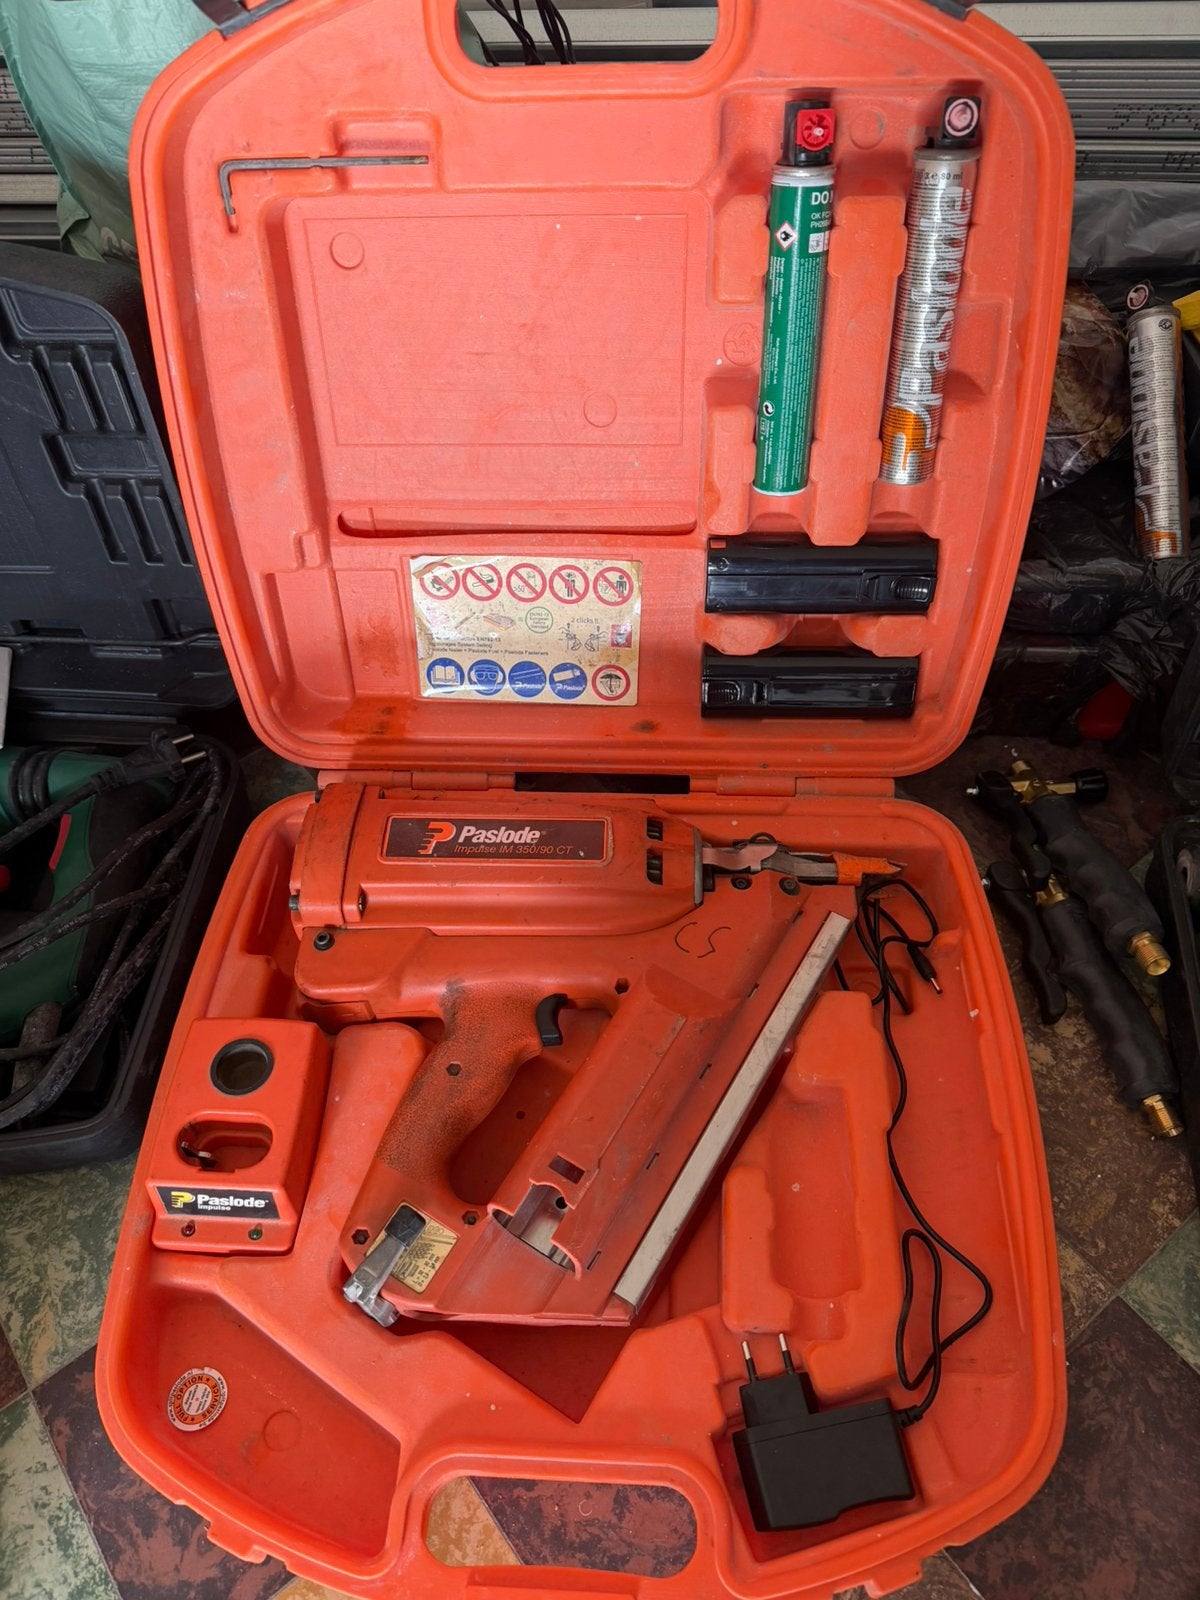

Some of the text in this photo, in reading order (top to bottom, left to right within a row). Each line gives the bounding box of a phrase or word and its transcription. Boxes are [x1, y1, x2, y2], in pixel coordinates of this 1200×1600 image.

[577, 616, 594, 624] clicks
[458, 825, 541, 844] Paslode
[454, 844, 574, 855] Impulse IM 350/90 CT
[197, 1193, 266, 1208] Paslode
[176, 1375, 204, 1400] OPTION
[201, 1383, 220, 1419] SERVICE
[176, 1403, 189, 1422] FULL
